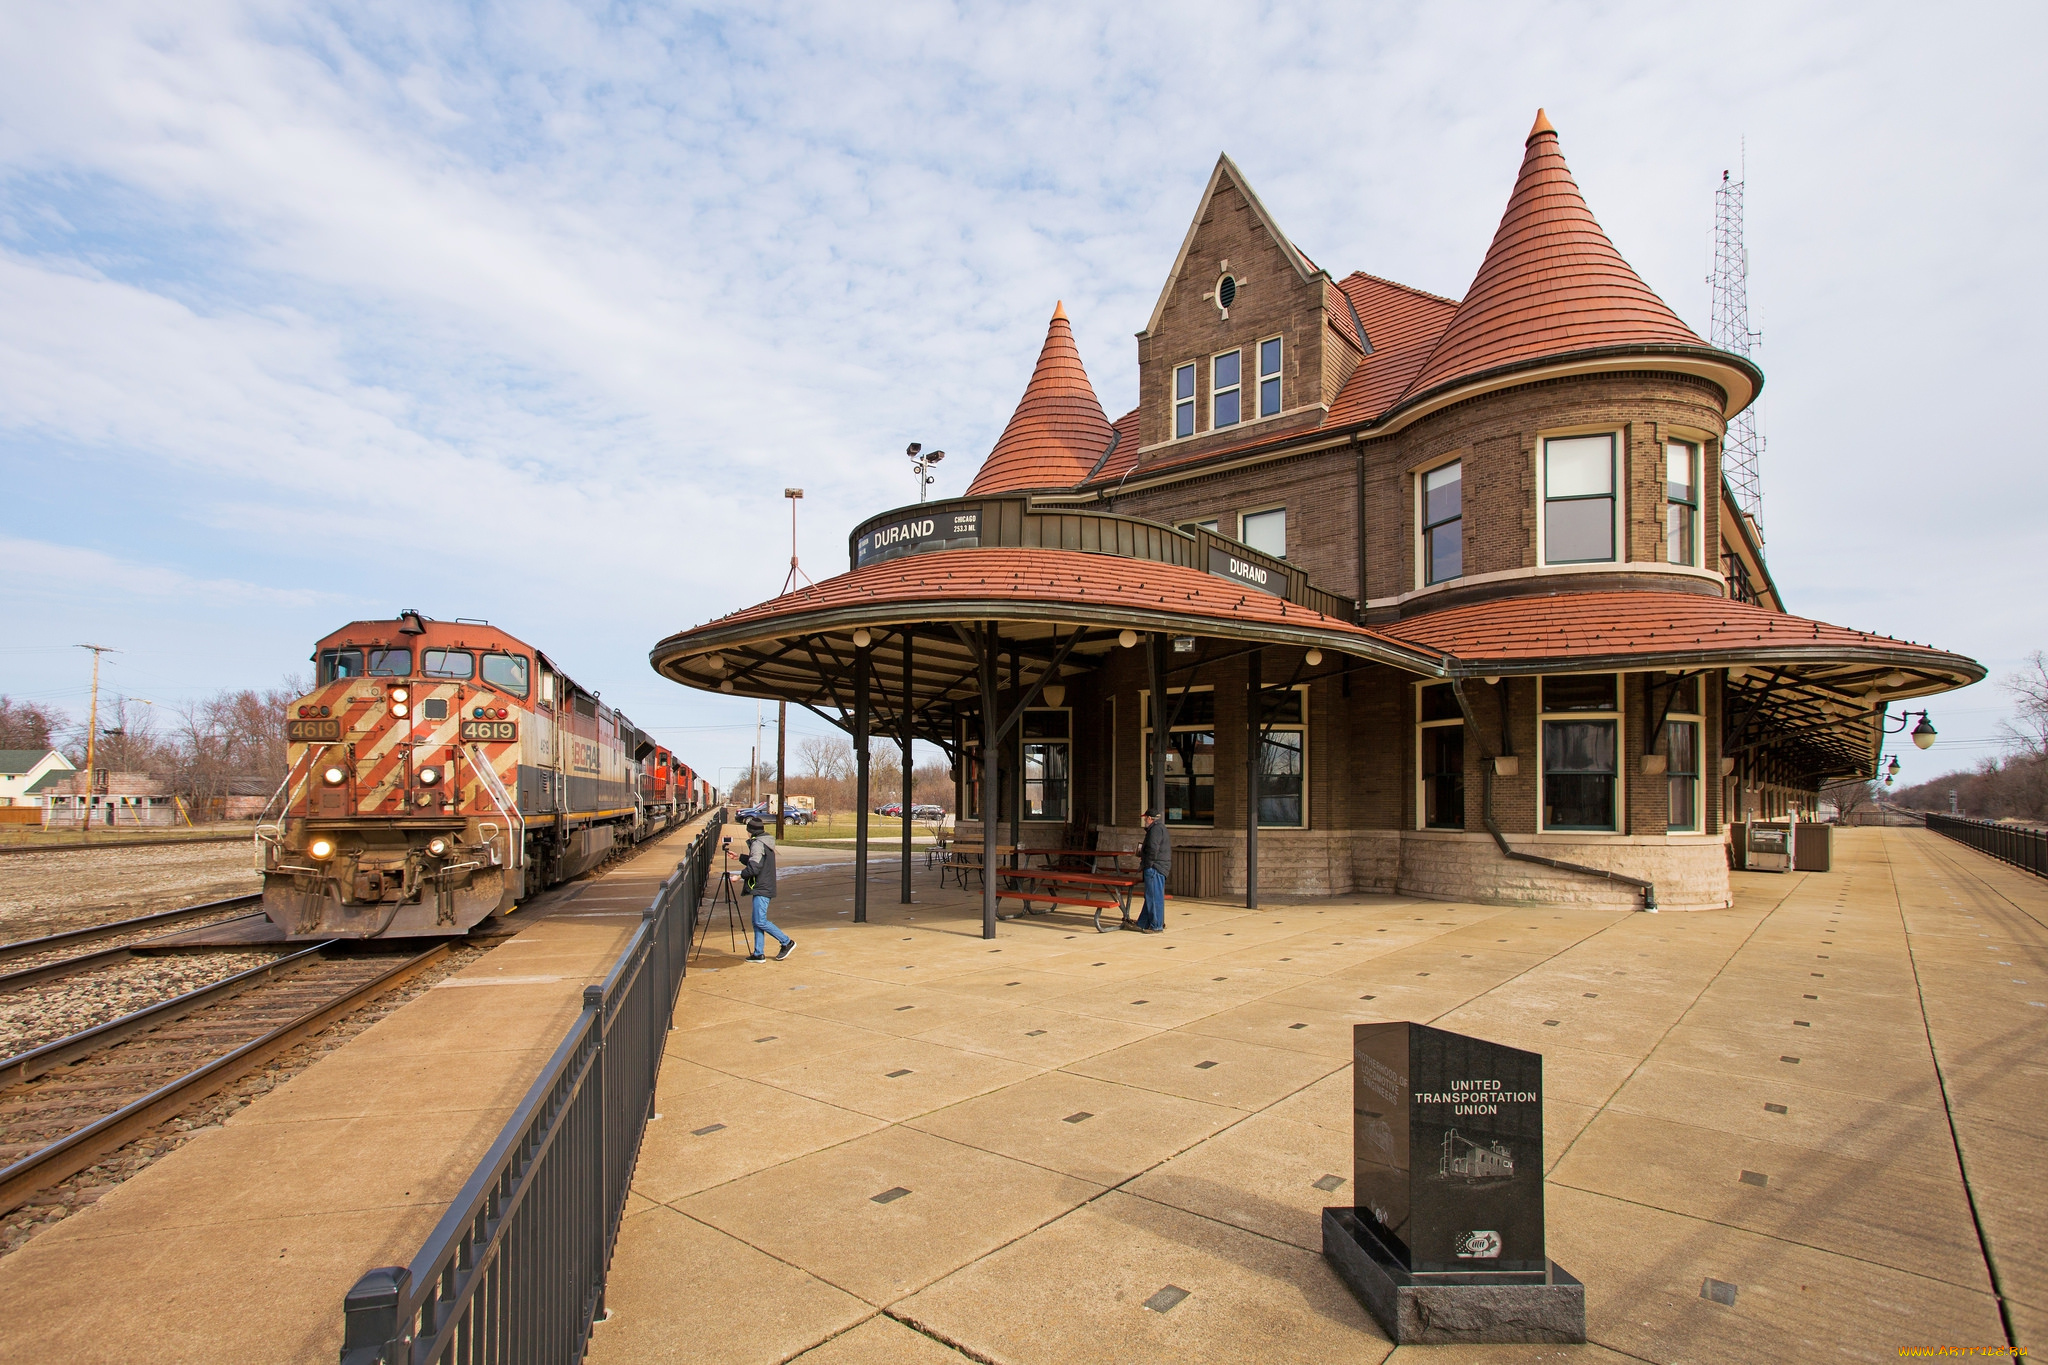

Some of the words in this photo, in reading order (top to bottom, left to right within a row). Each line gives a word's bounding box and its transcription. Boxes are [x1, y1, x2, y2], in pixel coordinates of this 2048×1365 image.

[954, 515, 977, 523] CHICAGO
[874, 519, 935, 549] DURAND
[953, 524, 968, 533] 253.3
[1230, 558, 1267, 584] DURAND
[292, 722, 337, 738] 4619
[464, 722, 513, 739] 4619
[1399, 1076, 1409, 1088] OF
[1451, 1080, 1501, 1091] UNITED
[1363, 1076, 1398, 1106] ENGINEERS
[1415, 1092, 1537, 1103] TRANSPORTATION
[1455, 1105, 1497, 1115] UNION
